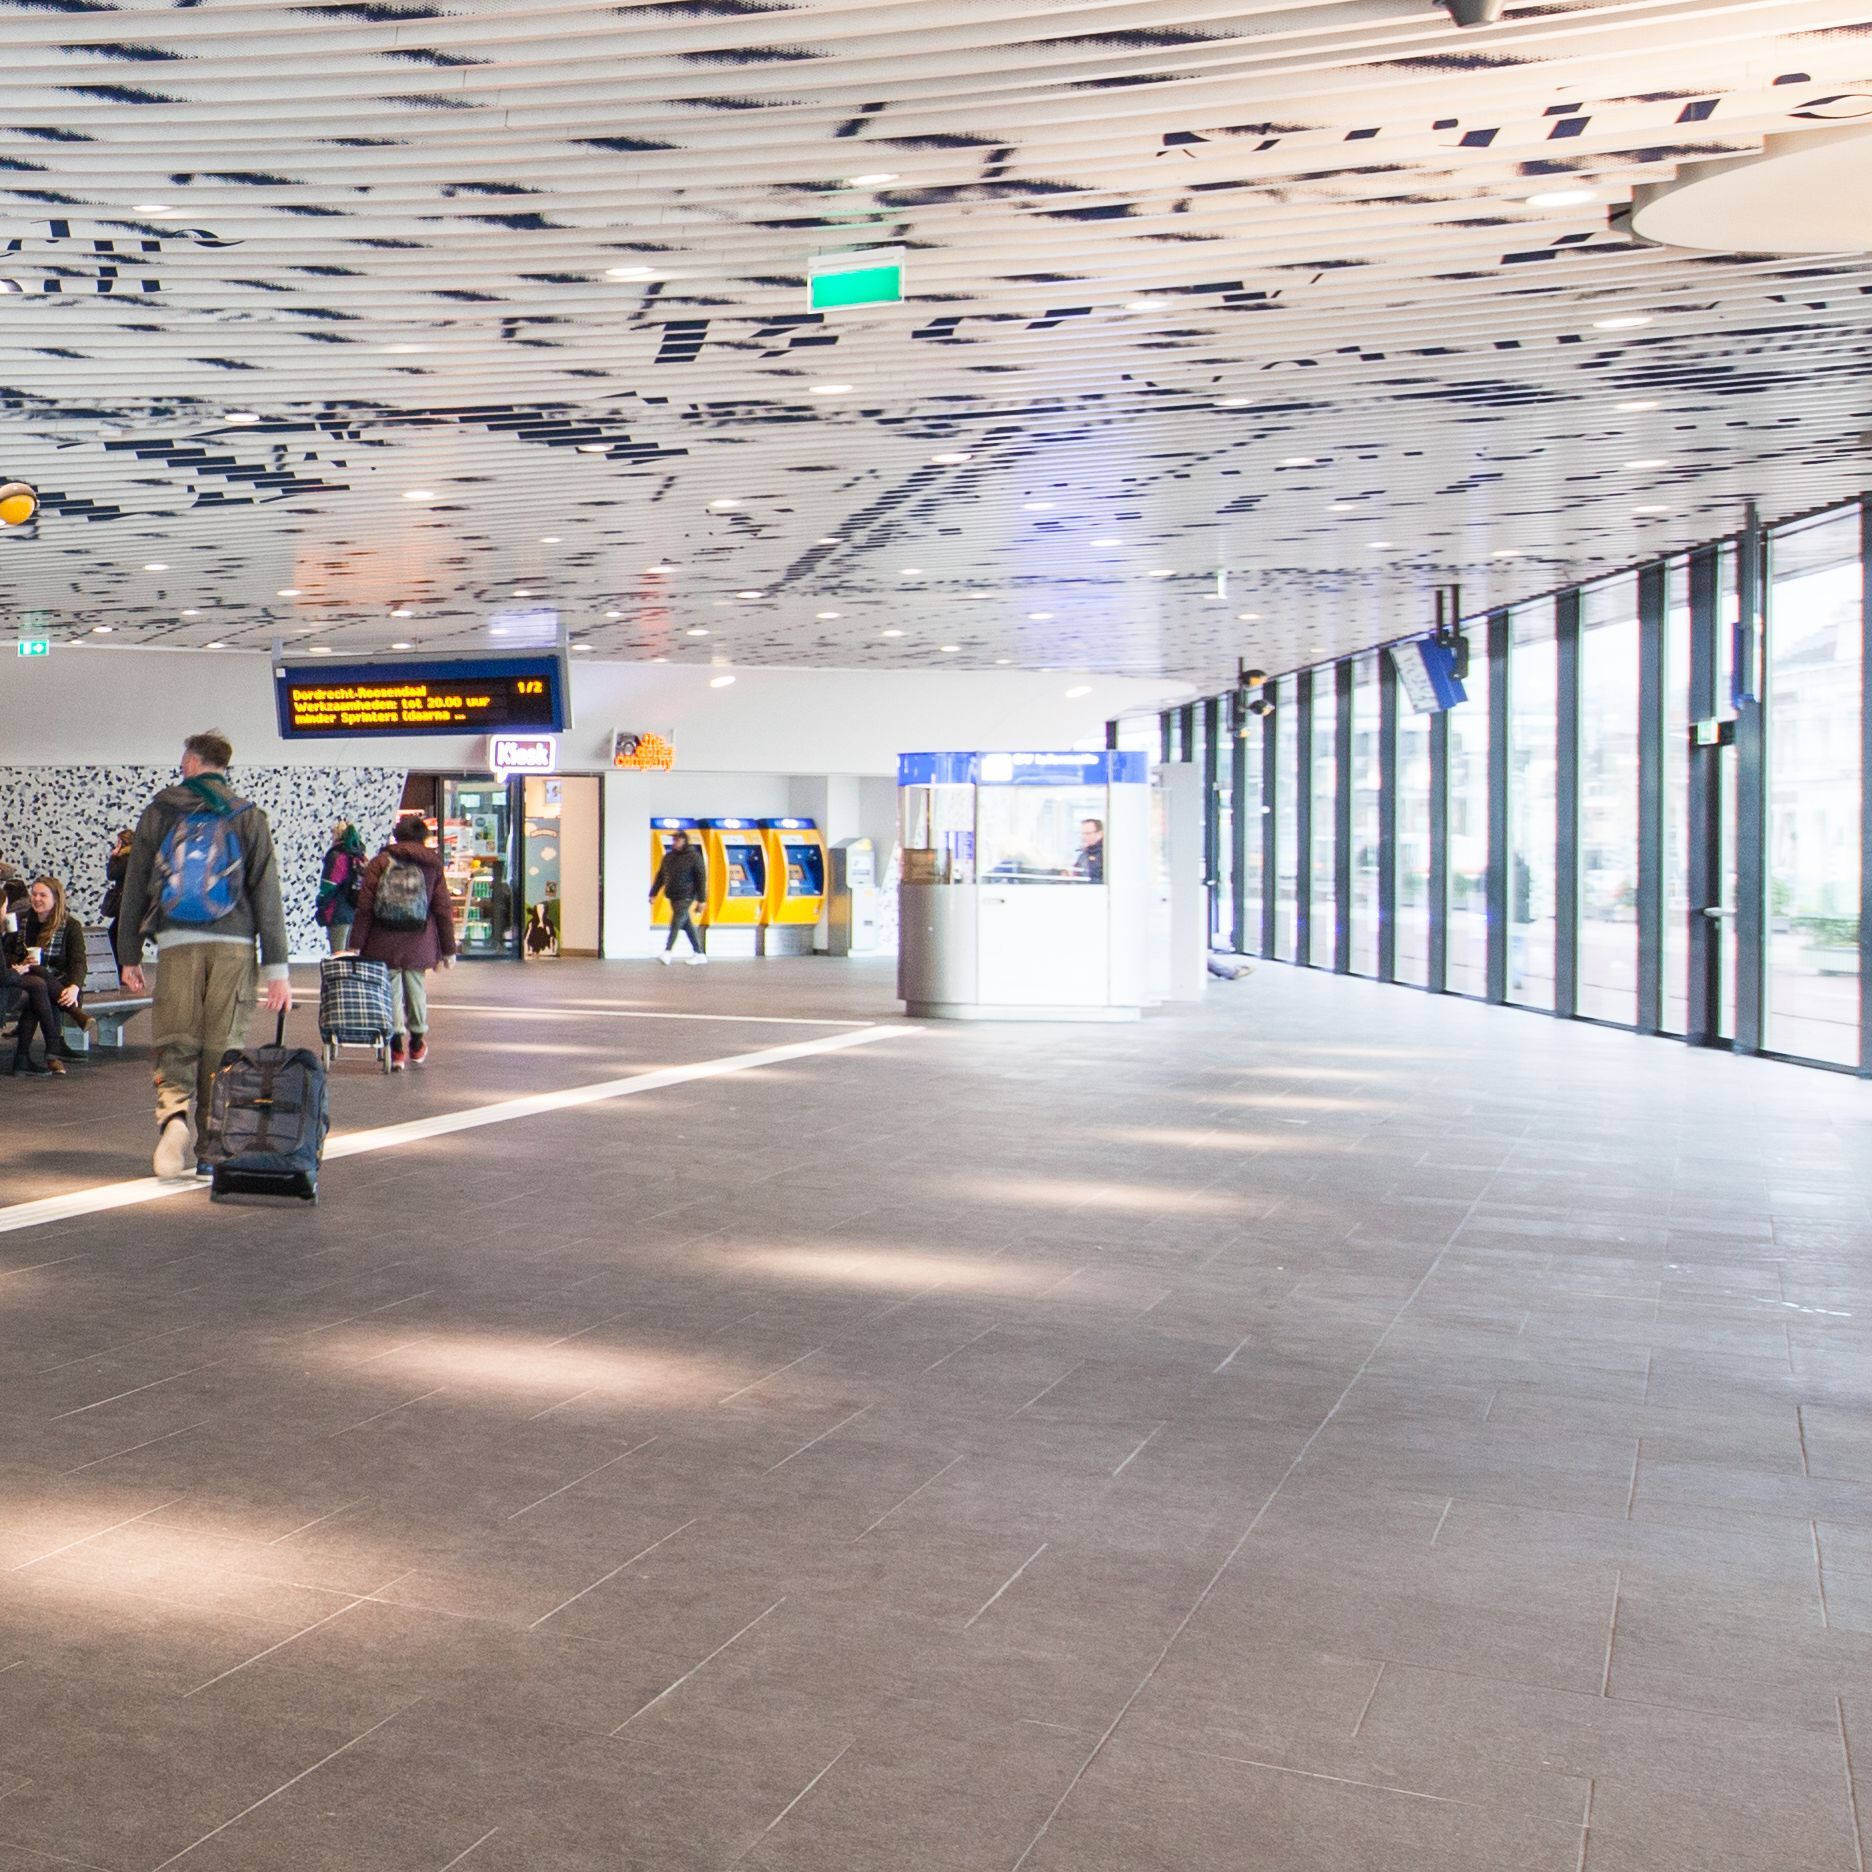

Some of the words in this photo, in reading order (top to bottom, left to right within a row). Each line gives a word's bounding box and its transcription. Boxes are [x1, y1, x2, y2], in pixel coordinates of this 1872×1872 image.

[293, 685, 427, 701] Dordrecht-Roosendaal
[517, 681, 543, 694] 1/2
[294, 699, 398, 713] Werkzaamheden:
[401, 698, 424, 709] tot
[427, 696, 463, 709] 20.00
[465, 696, 490, 708] uur
[294, 713, 337, 725] minder
[341, 711, 398, 725] Sprinters
[496, 740, 550, 767] Kiosk
